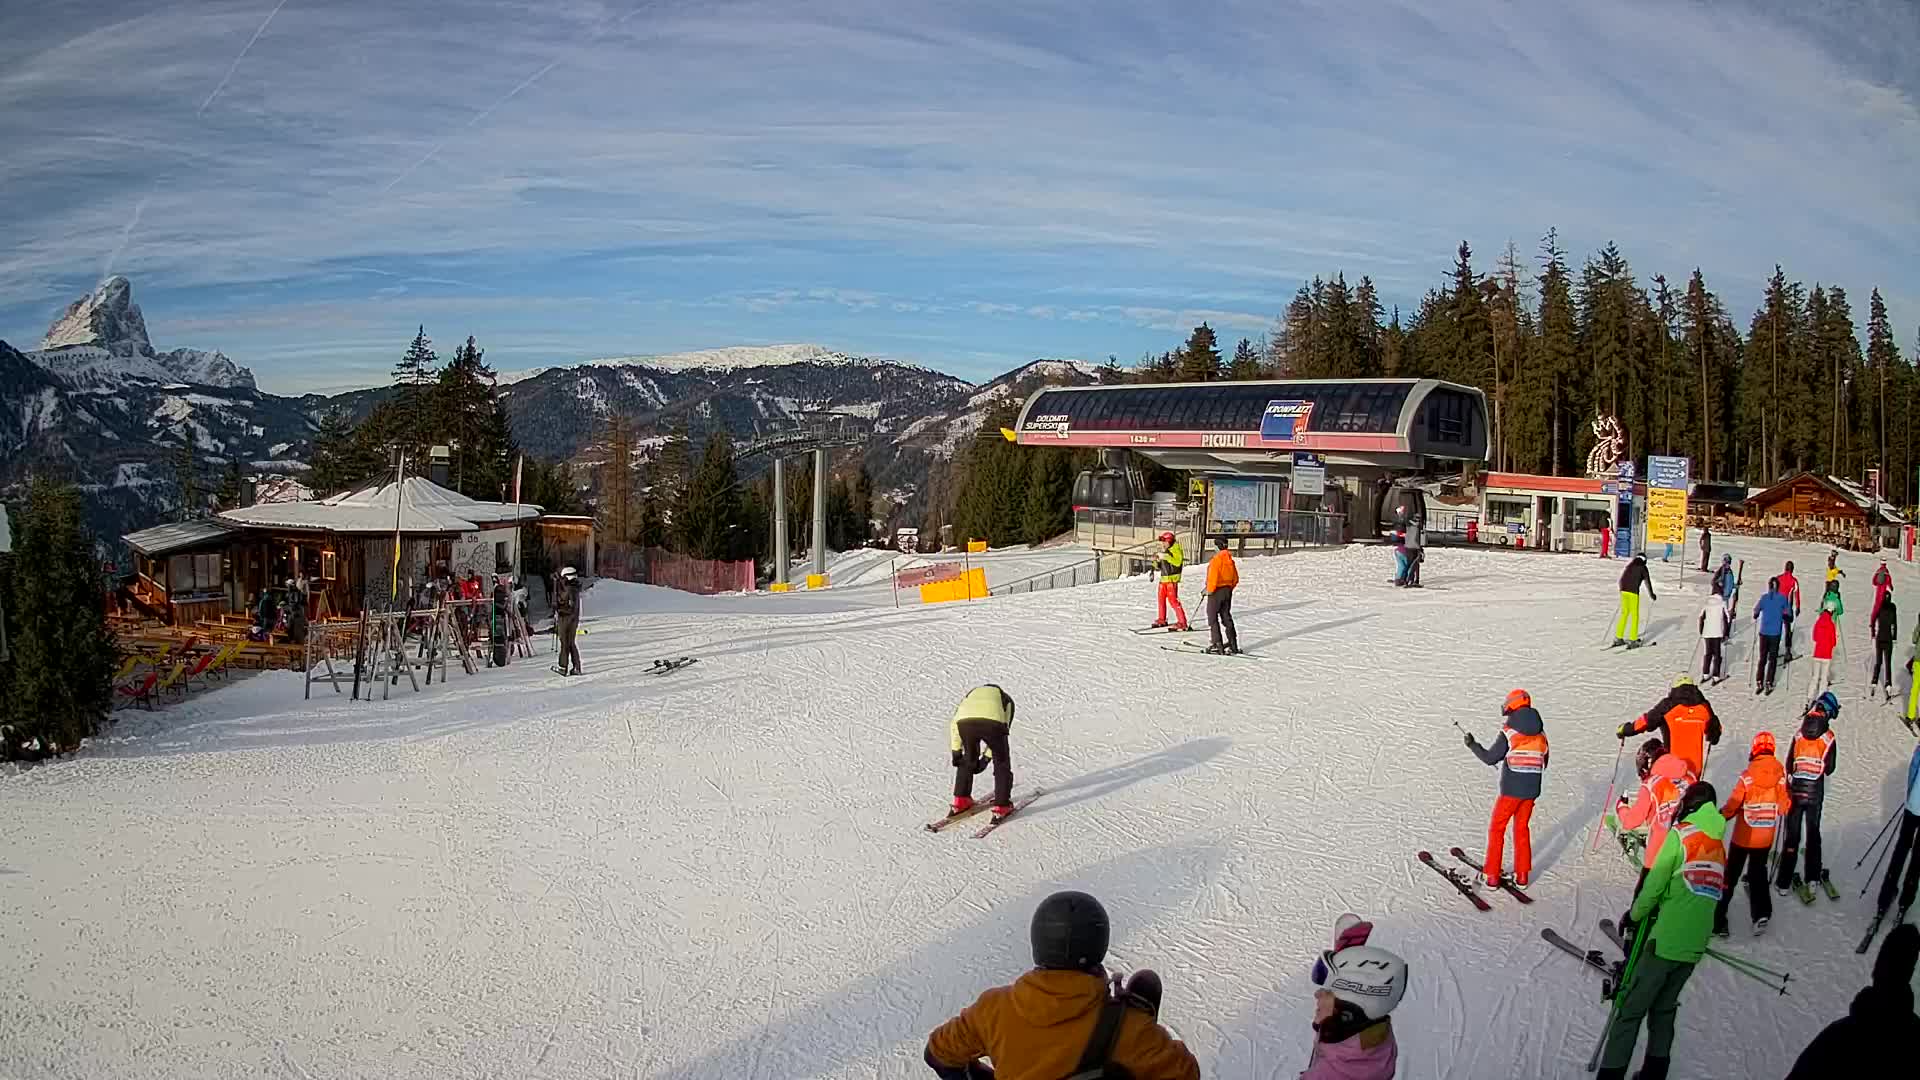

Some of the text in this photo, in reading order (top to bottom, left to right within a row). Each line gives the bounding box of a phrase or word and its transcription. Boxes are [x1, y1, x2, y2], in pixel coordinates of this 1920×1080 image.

[1267, 405, 1311, 413] KRONPLATZ
[1035, 414, 1069, 422] DOLOMITI
[1024, 422, 1059, 430] SUPERSKI
[1201, 434, 1245, 448] PICULIN
